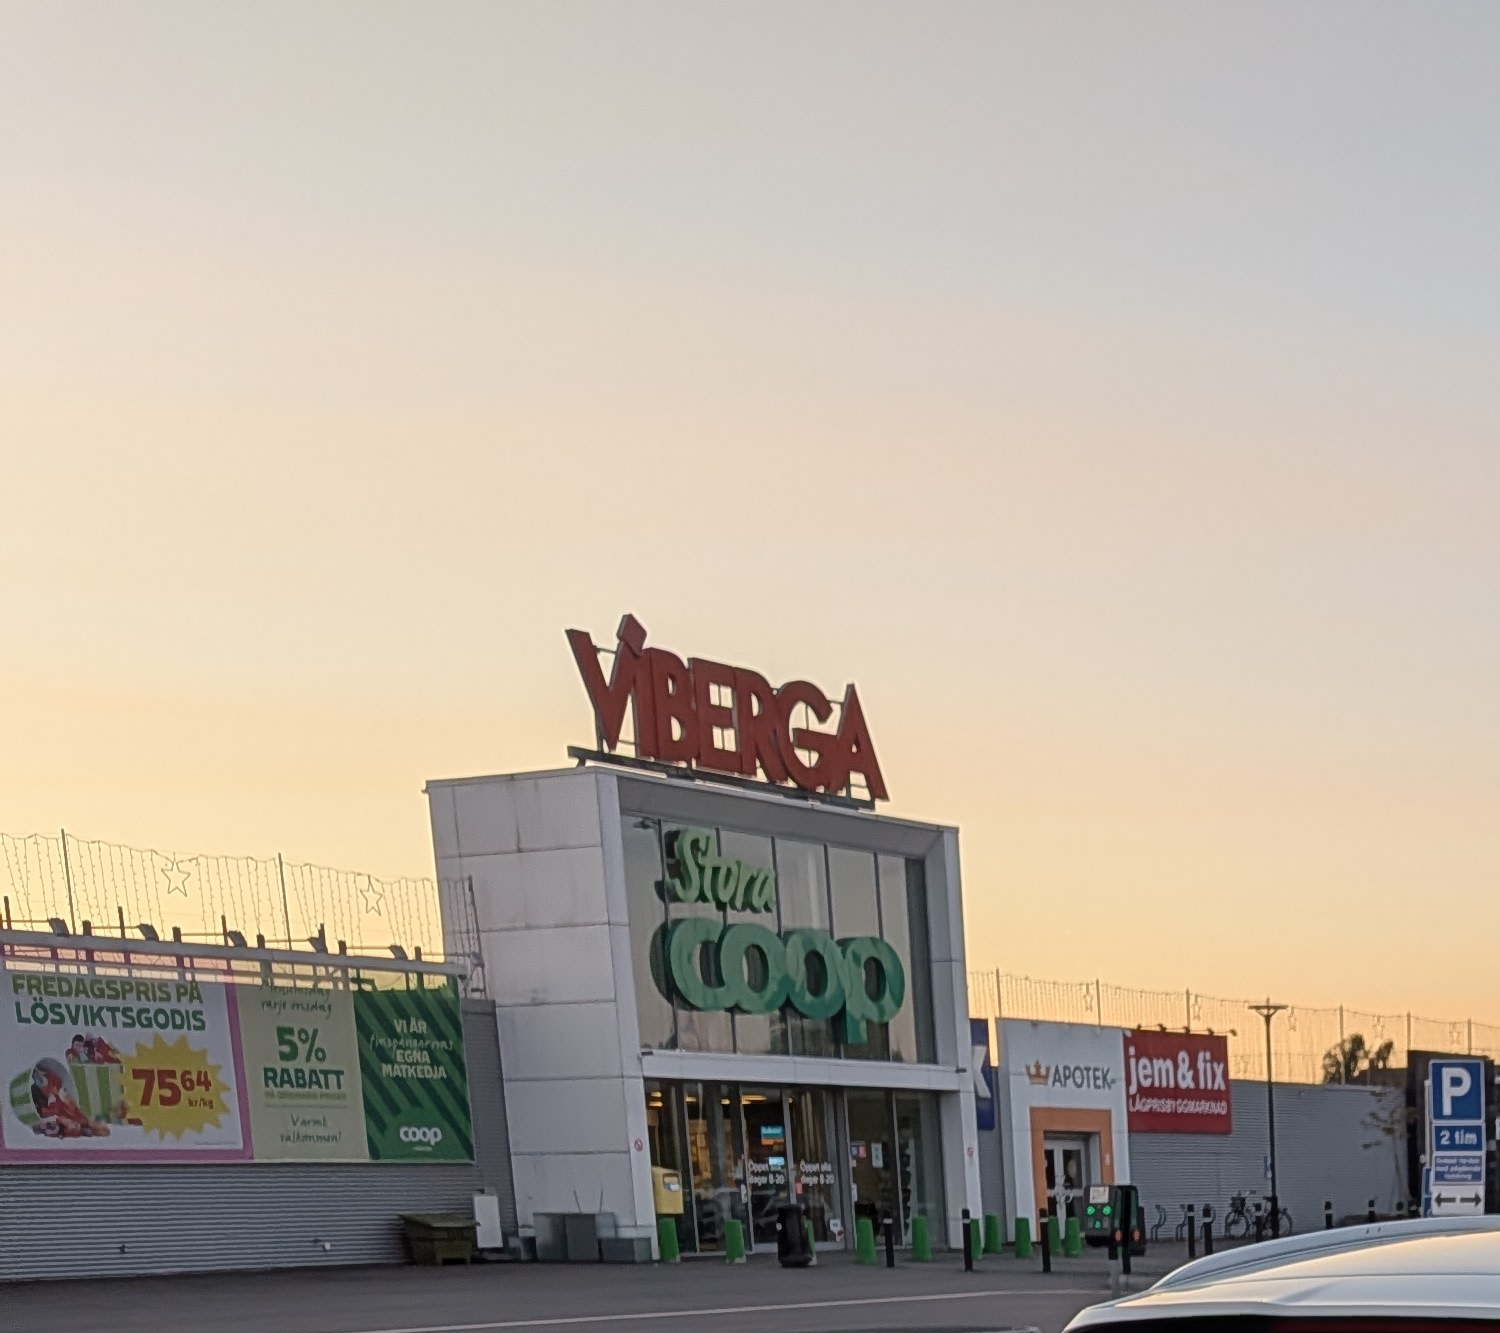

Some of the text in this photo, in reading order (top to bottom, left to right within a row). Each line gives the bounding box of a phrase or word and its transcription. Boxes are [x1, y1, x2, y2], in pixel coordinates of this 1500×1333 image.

[565, 613, 890, 802] VIBERGA
[672, 828, 776, 912] Stora
[11, 974, 204, 1004] FREDAGSPRIS PÅ
[660, 918, 905, 1045] coop
[15, 996, 206, 1031] LÖSVIKTSGODIS
[276, 1025, 327, 1063] 5%
[396, 1048, 431, 1064] EGNA
[263, 1066, 345, 1090] RABATT
[381, 1062, 447, 1079] MATKEDJA
[1051, 1064, 1112, 1091] APOTEK
[1128, 1045, 1227, 1096] jem & fix
[1442, 1067, 1472, 1116] P
[399, 1127, 442, 1146] coop
[1440, 1128, 1478, 1145] 2 tim
